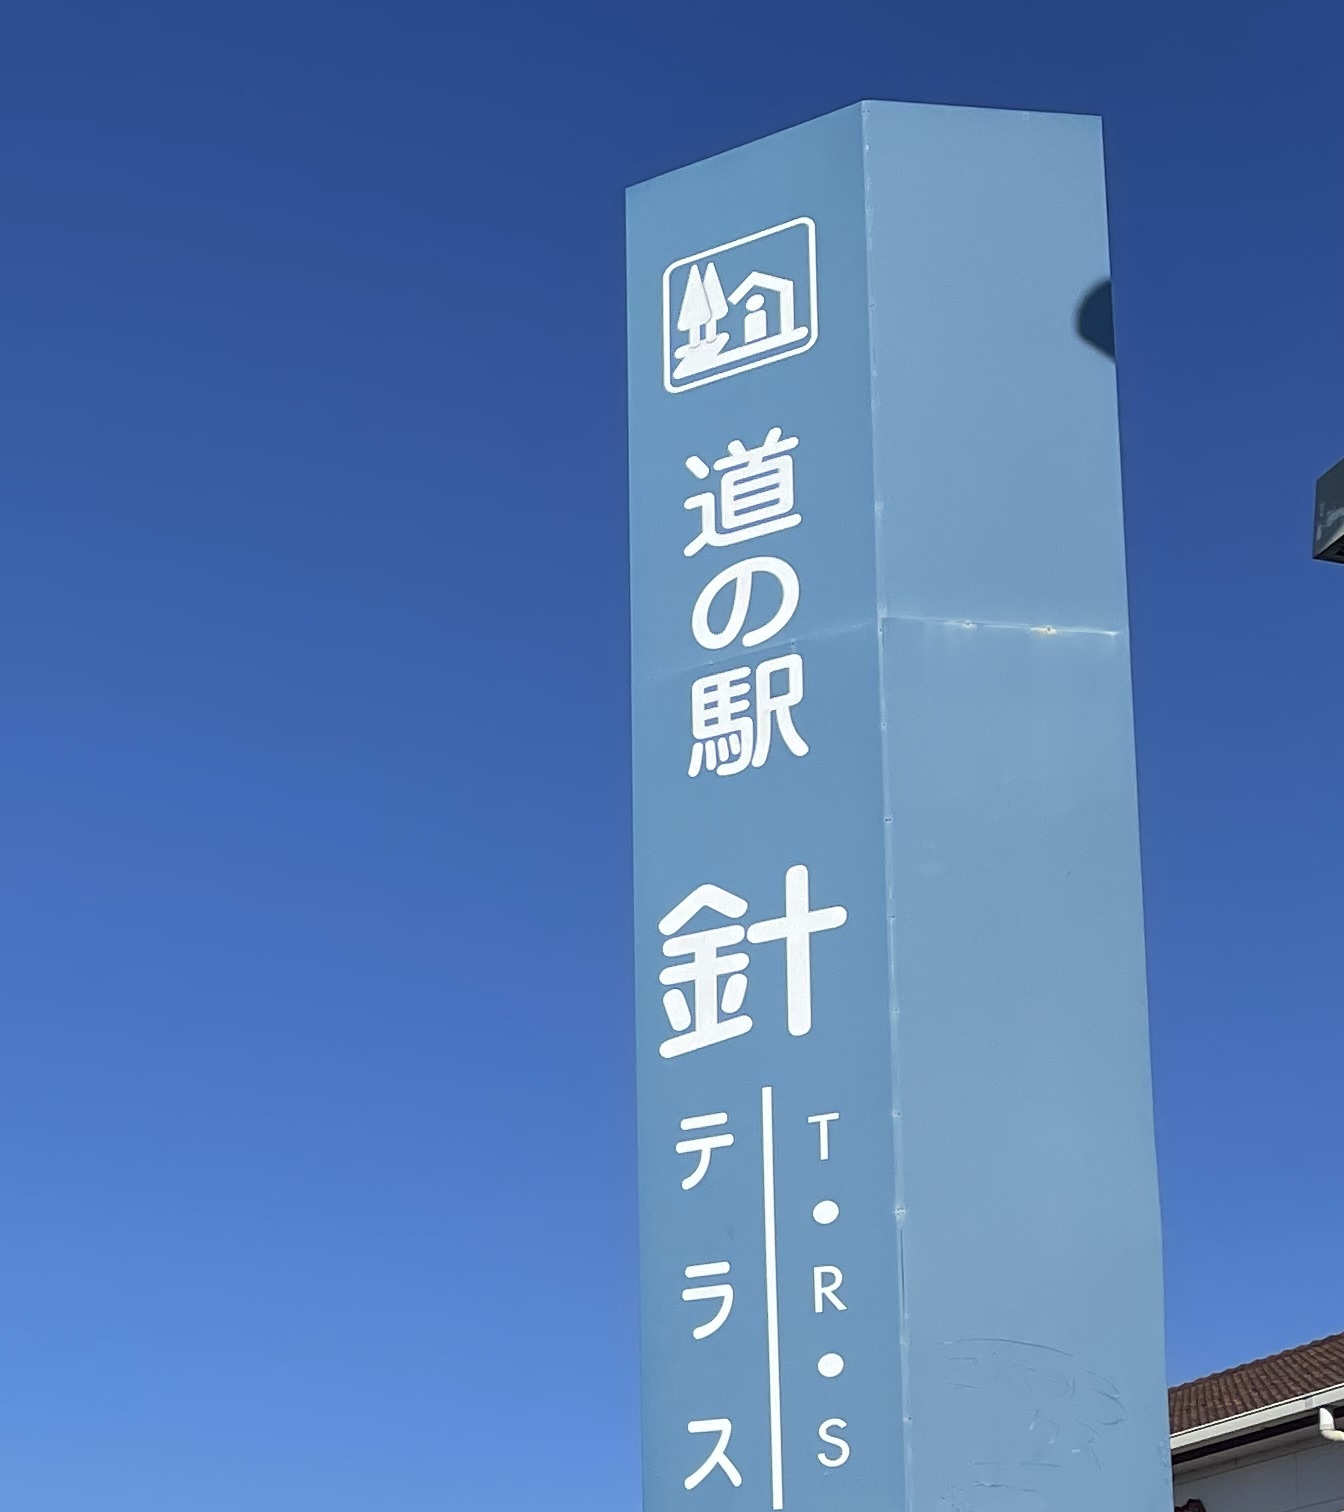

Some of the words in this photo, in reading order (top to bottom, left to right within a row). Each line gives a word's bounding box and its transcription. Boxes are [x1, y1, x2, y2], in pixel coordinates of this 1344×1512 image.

[684, 427, 808, 777] 道の駅
[659, 865, 847, 1058] 針
[676, 1112, 742, 1490] テラス
